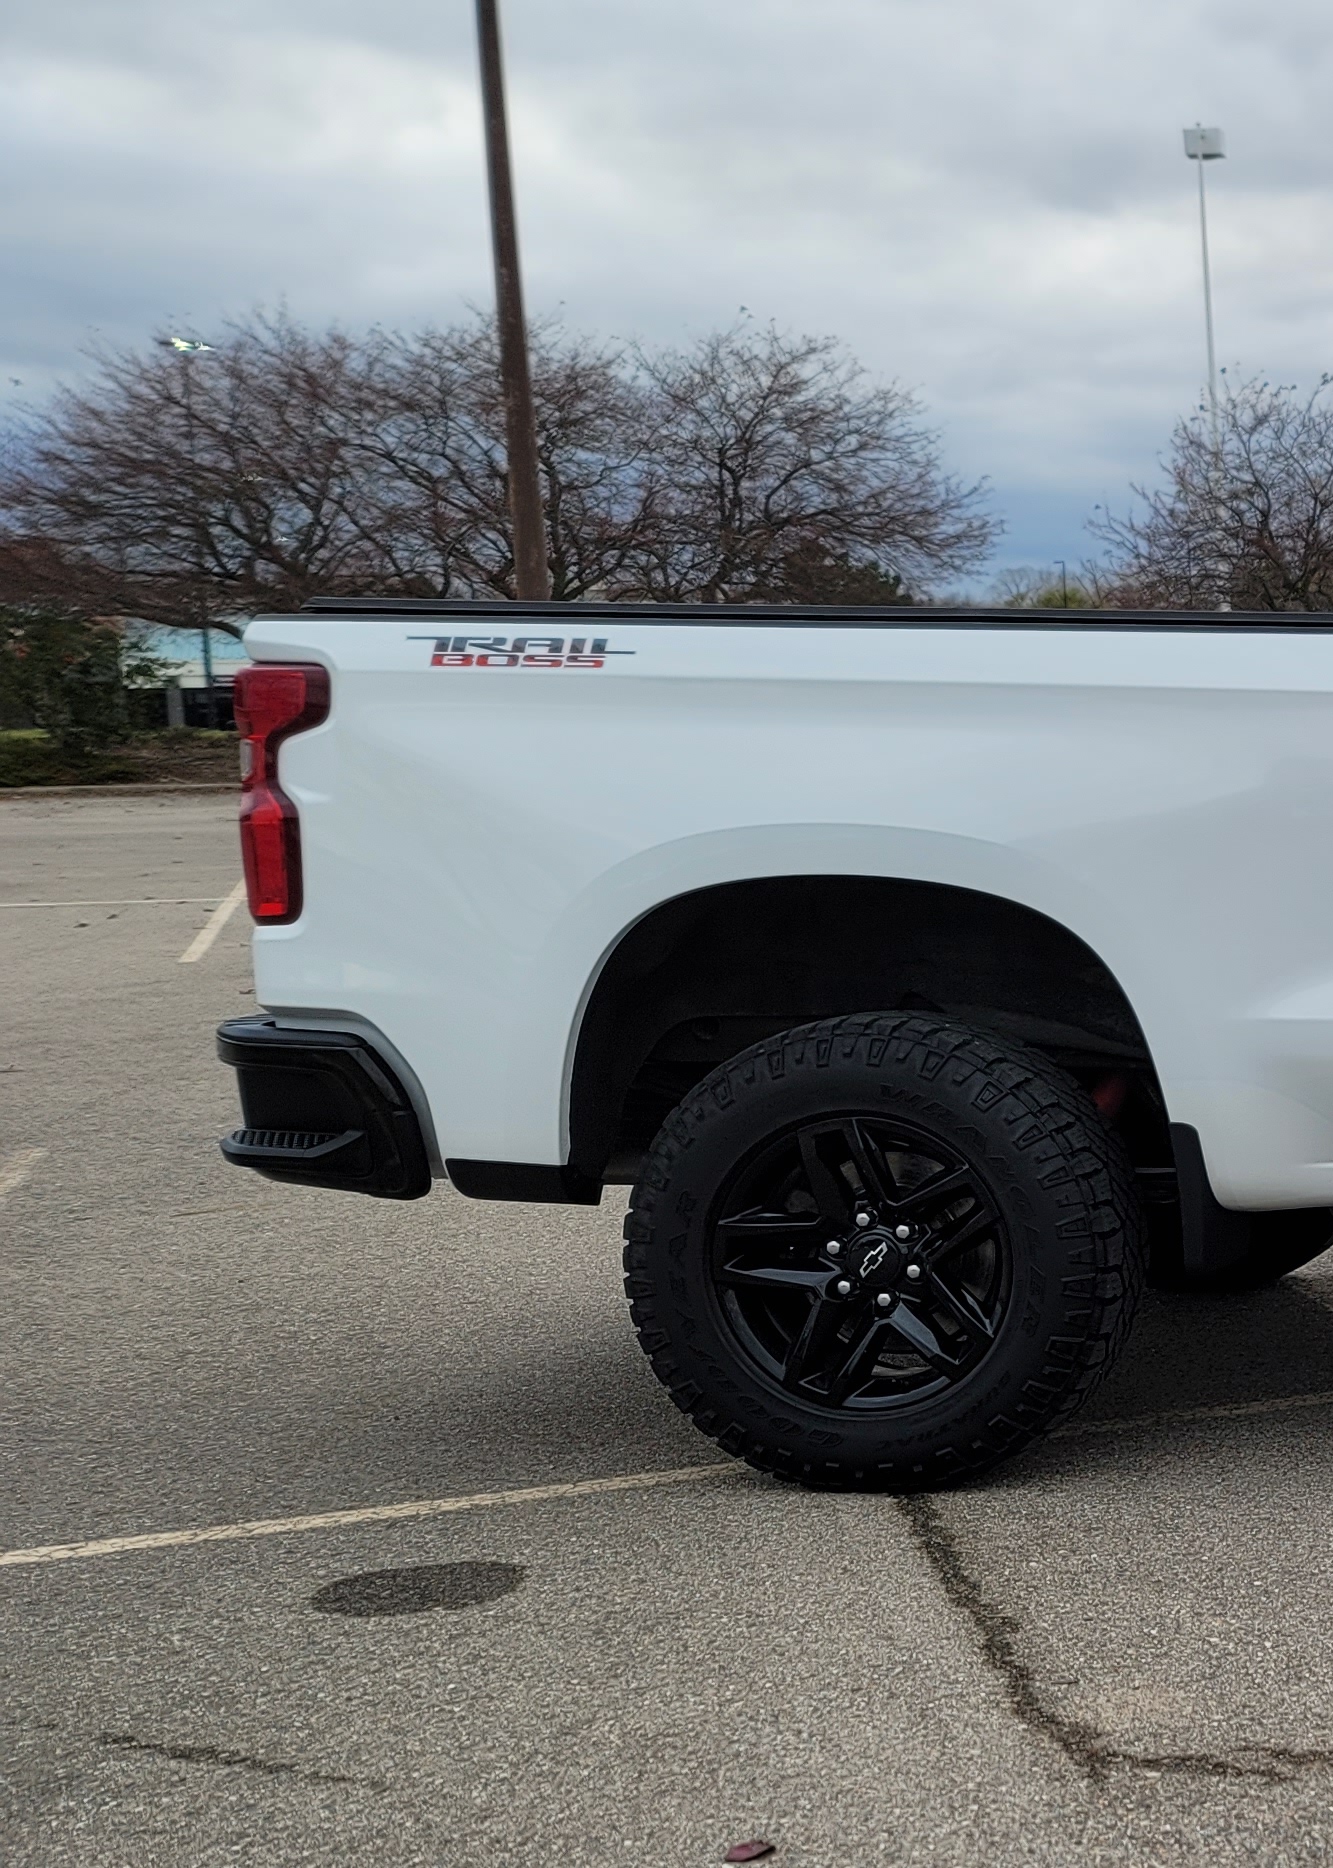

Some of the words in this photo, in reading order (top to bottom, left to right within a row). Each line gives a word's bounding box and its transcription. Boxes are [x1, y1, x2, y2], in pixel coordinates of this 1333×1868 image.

[406, 636, 637, 655] TRAIL
[430, 653, 606, 668] BOSS
[880, 1082, 1047, 1338] WRANGLER
[669, 1190, 843, 1448] GOODYEAR
